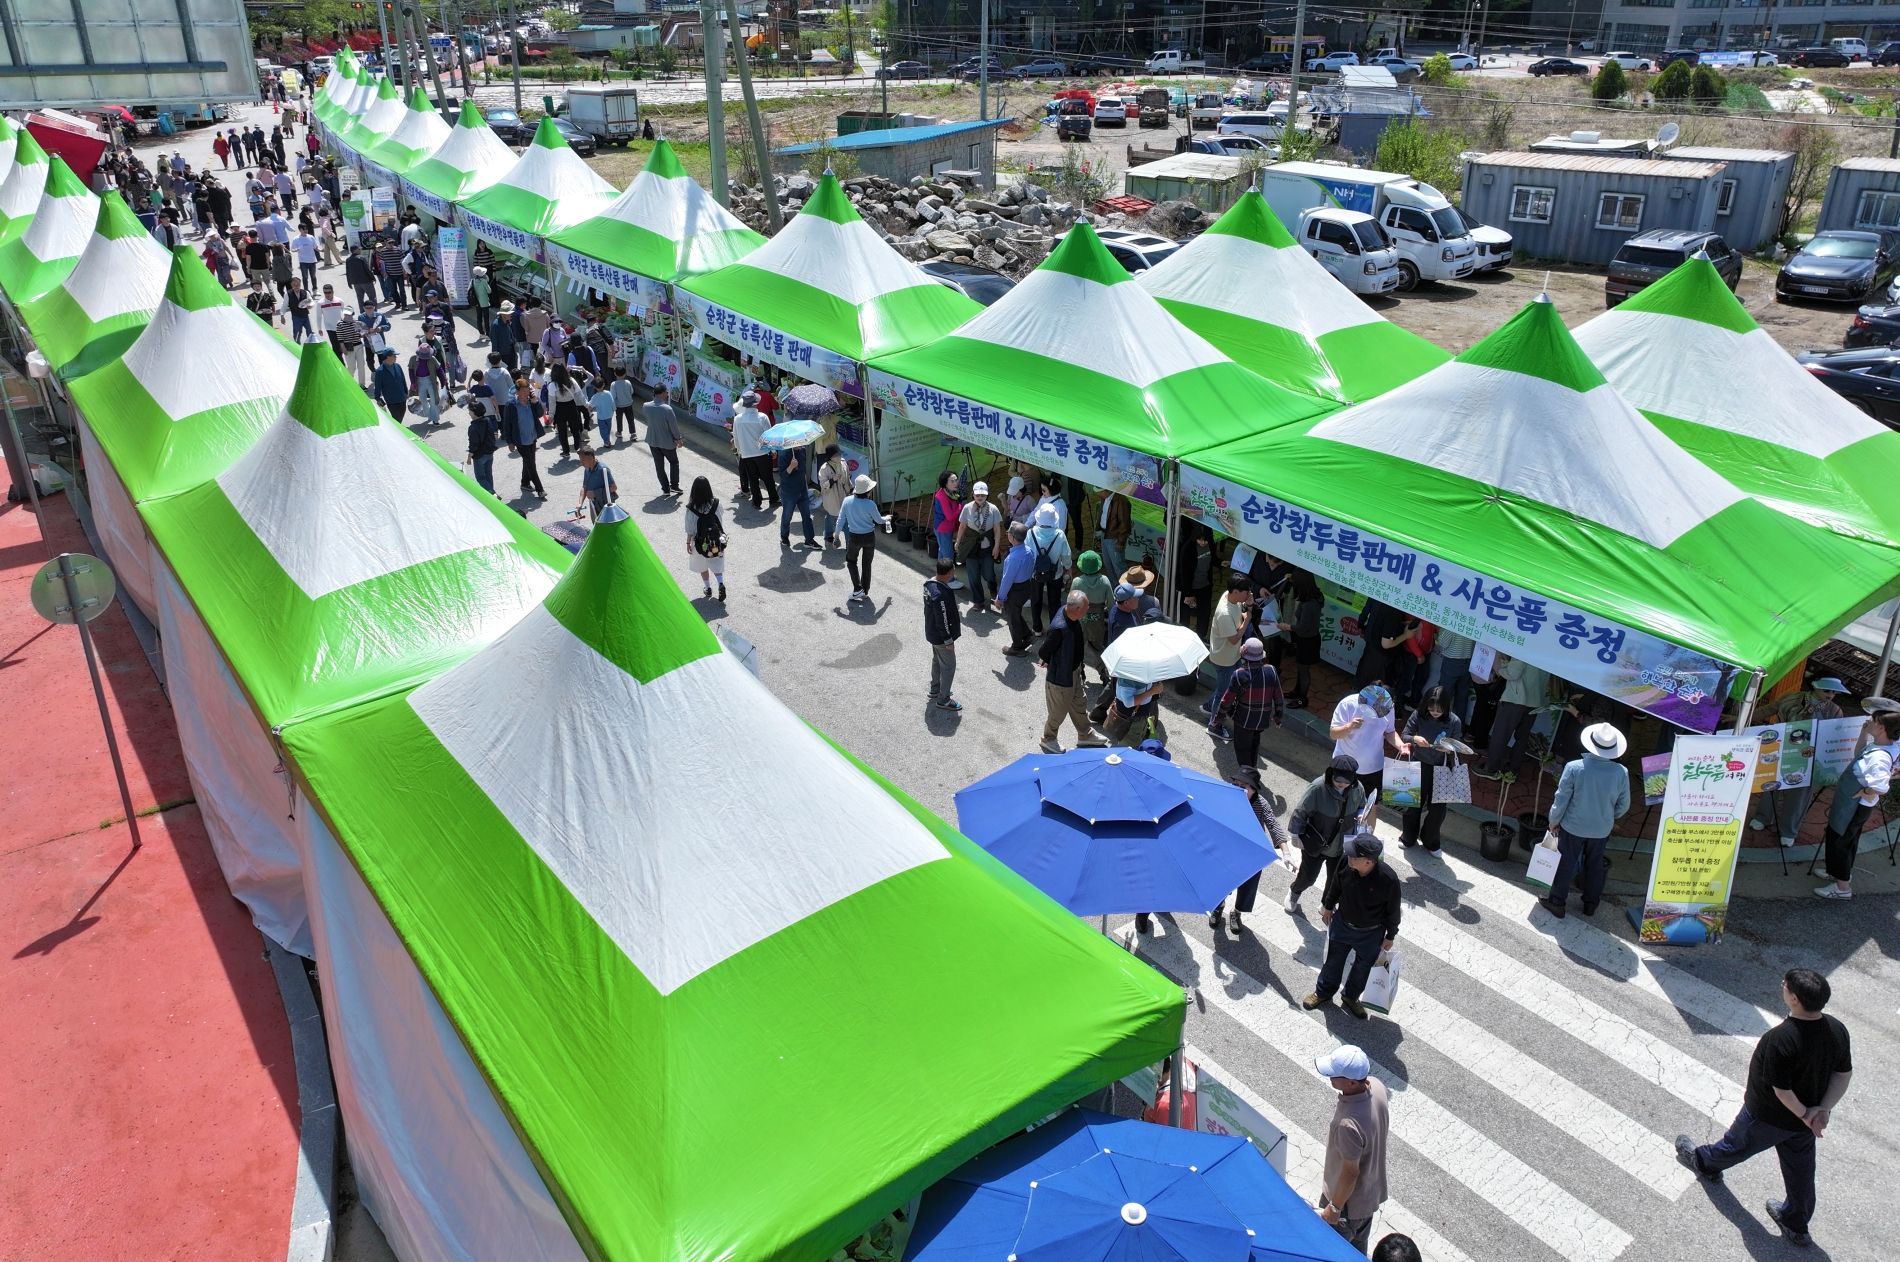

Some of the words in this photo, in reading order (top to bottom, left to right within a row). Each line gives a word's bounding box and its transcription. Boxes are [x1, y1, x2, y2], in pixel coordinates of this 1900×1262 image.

[1333, 186, 1354, 199] NH
[567, 253, 589, 276] 순창군
[590, 261, 621, 288] 농특산물
[622, 273, 639, 295] 판매
[705, 304, 737, 335] 순창군
[739, 319, 785, 356] 농특산물
[788, 340, 813, 369] 판매
[903, 384, 1000, 436] 순창참두릅판매
[1004, 417, 1017, 441] &
[1020, 422, 1070, 458] 사은품
[1073, 438, 1110, 471] 증정
[1239, 494, 1417, 585] 순창참두릅판매
[1421, 562, 1444, 596] &
[1450, 577, 1548, 635] 사은품
[1555, 613, 1626, 665] 증정
[1482, 622, 1526, 647] 서순창농협
[1682, 761, 1726, 791] 참두릅
[1700, 815, 1714, 823] 증정
[1671, 857, 1691, 865] 참두릅
